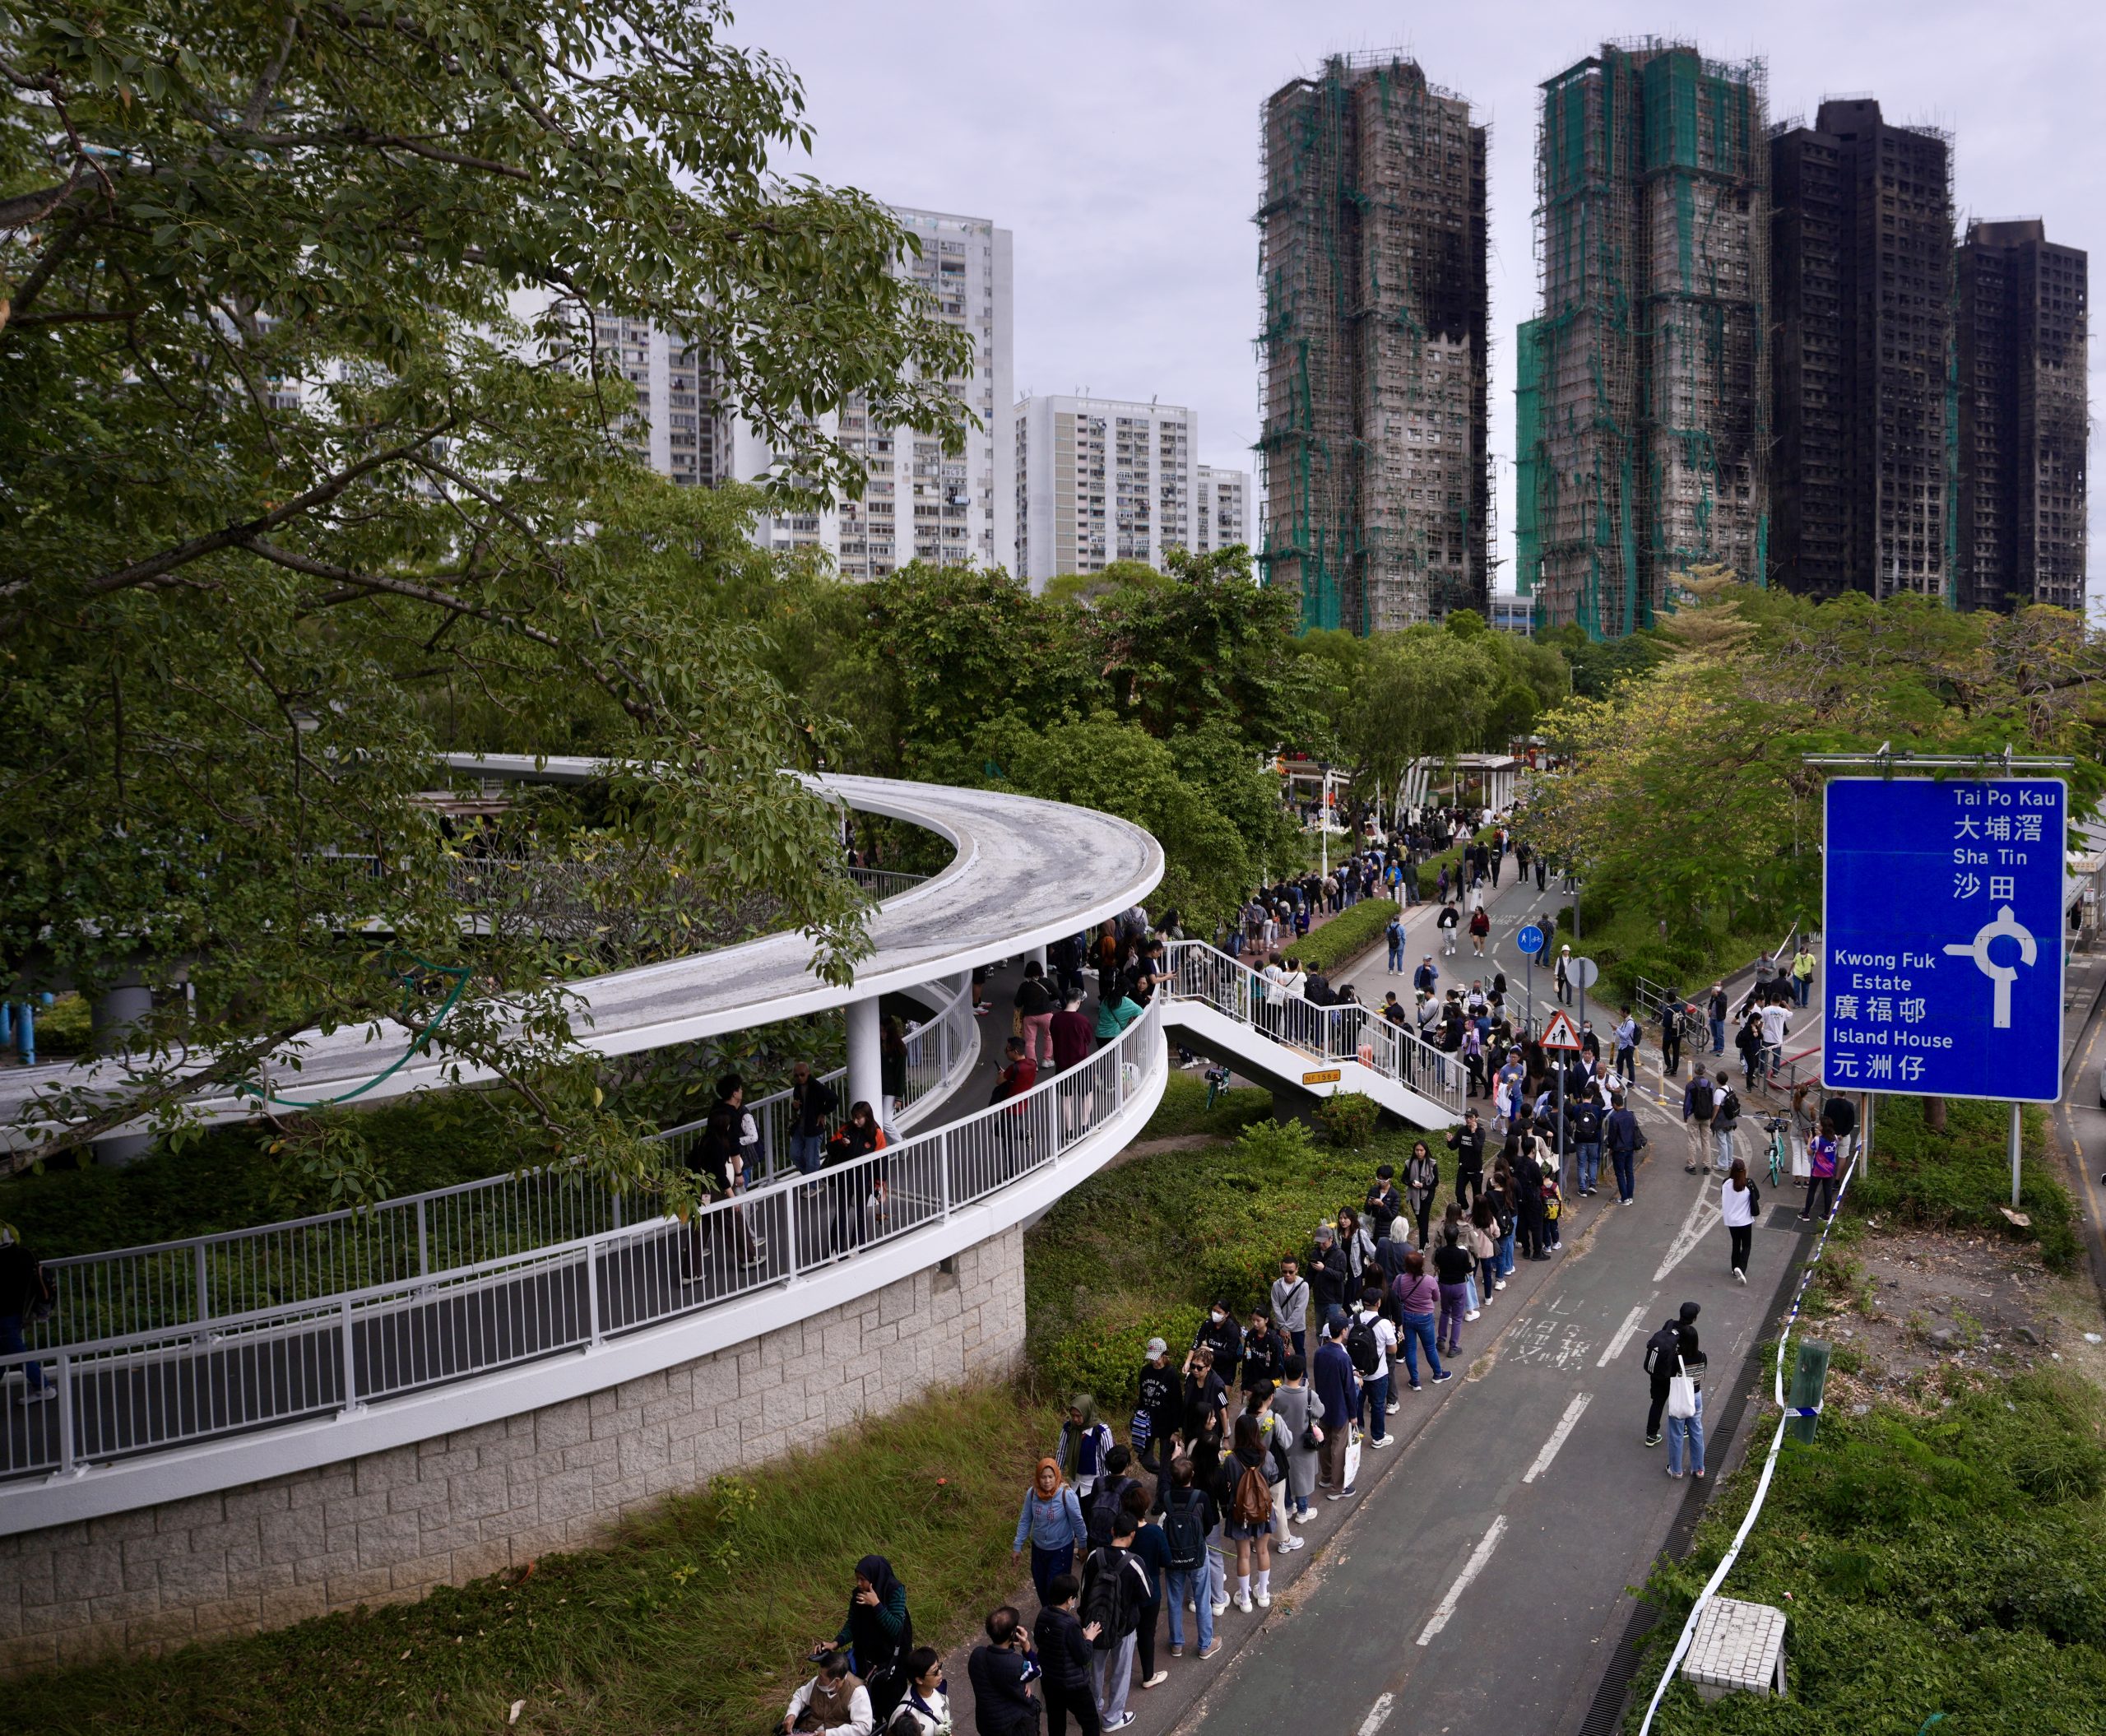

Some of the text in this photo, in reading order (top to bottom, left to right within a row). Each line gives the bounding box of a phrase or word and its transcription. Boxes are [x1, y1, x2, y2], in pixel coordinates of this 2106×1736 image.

[1954, 790, 2055, 806] Tai Po Kau
[1954, 815, 2043, 842] 大埔滘
[1954, 848, 2027, 865] Sha Tin
[1953, 873, 2015, 901] 沙田
[1835, 949, 1936, 970] Kwong Fuk
[1853, 973, 1912, 991] Estate
[1834, 994, 1926, 1023] 廣福邨
[1834, 1027, 1953, 1048] Island House
[1833, 1052, 1926, 1081] 元洲仔
